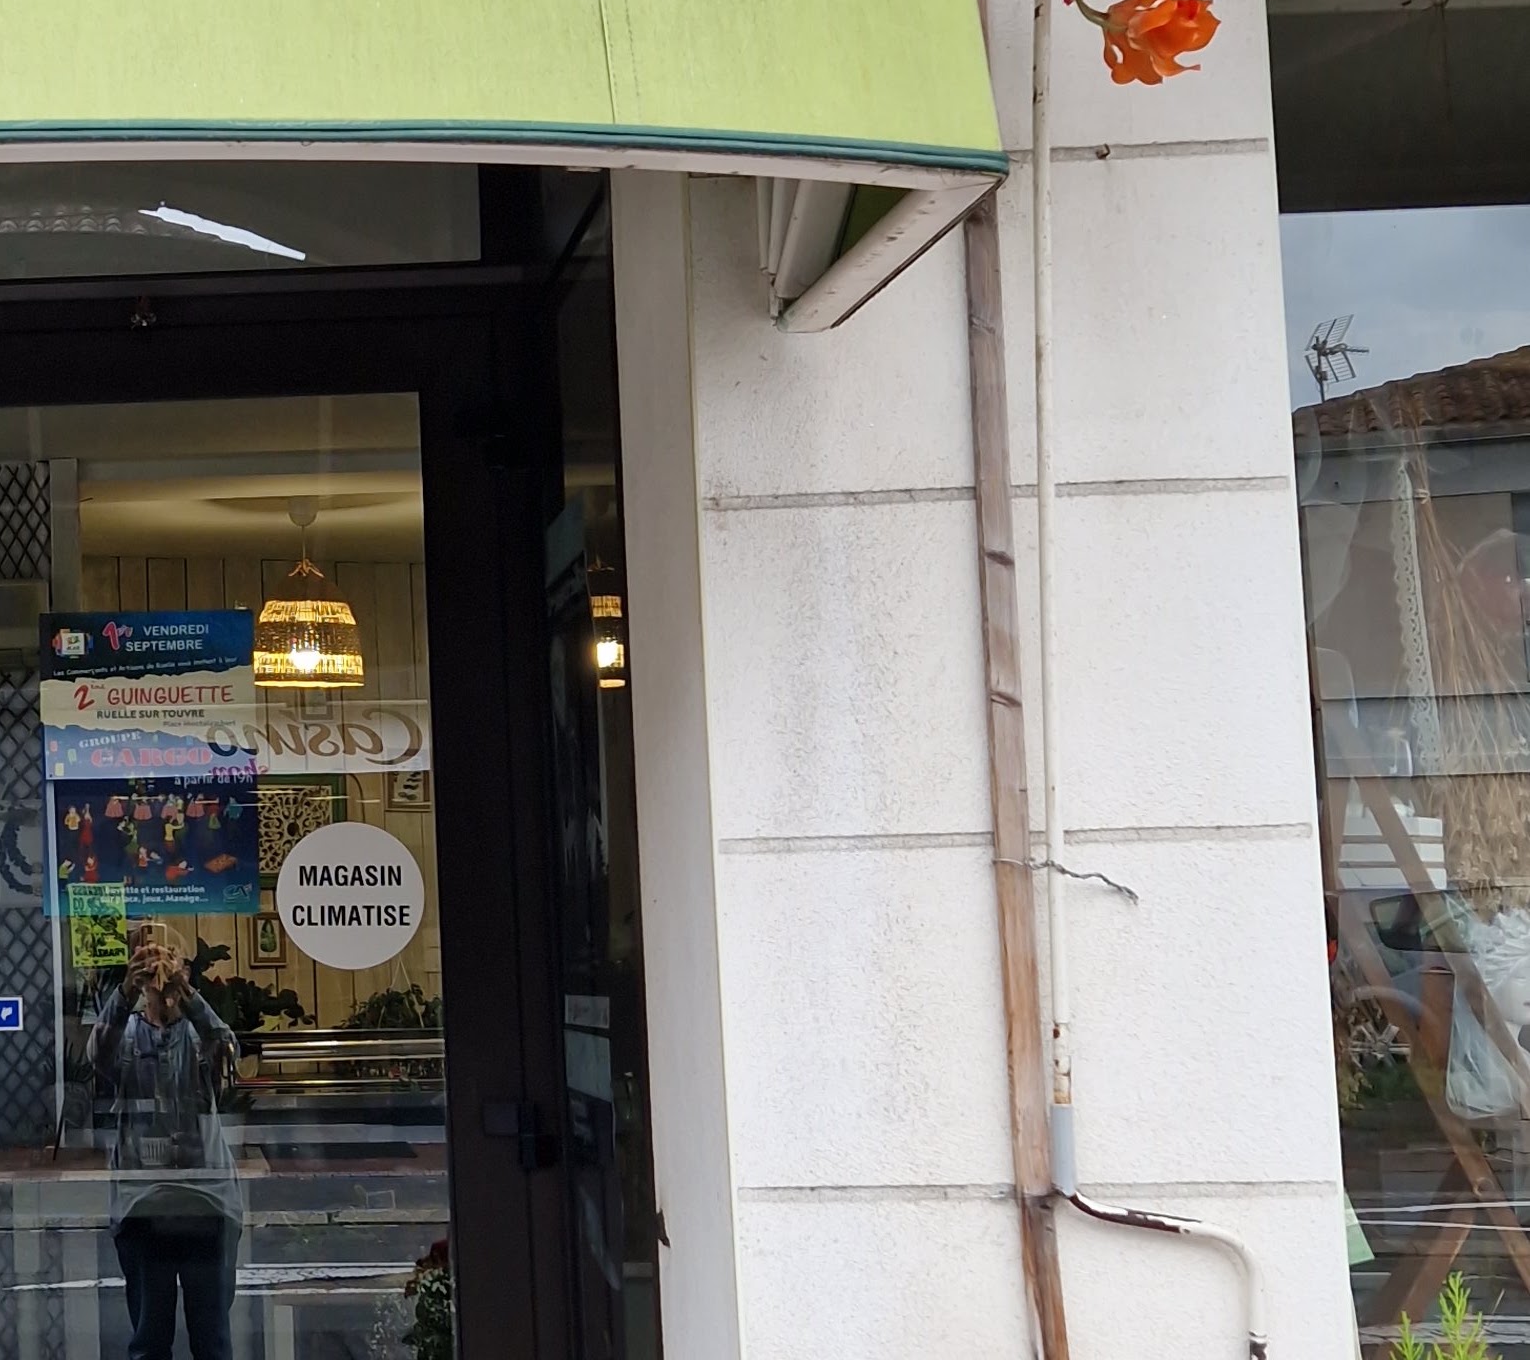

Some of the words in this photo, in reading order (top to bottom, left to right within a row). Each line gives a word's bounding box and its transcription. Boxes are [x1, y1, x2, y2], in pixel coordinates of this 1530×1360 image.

[143, 624, 210, 636] VENDREDI
[125, 639, 204, 652] SEPTEMBRE
[107, 684, 235, 706] GUINGUETTE
[96, 710, 137, 719] RUELLE
[139, 709, 160, 719] SUR
[162, 709, 205, 718] TOUVRE
[79, 730, 142, 748] GROUPE
[299, 865, 402, 887] MAGASIN
[152, 884, 206, 895] restauration
[292, 905, 411, 927] CLIMATISE
